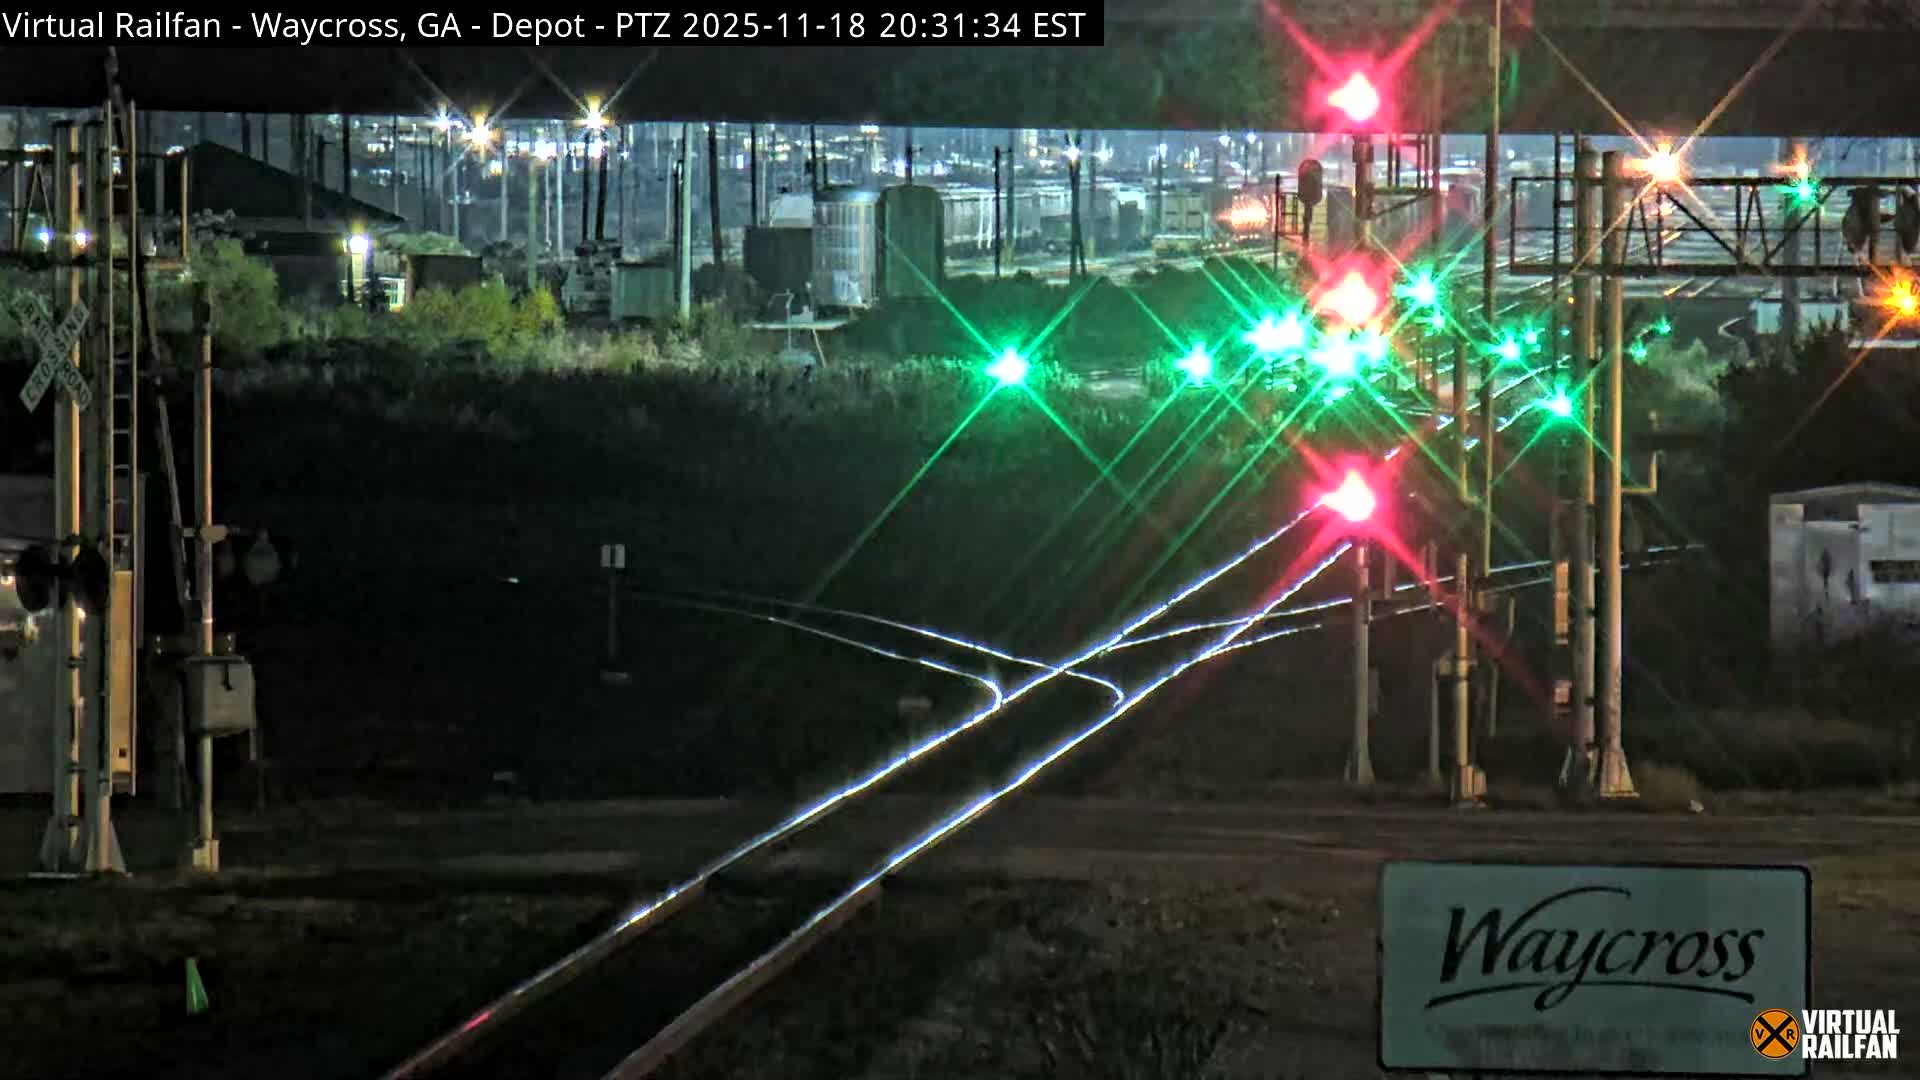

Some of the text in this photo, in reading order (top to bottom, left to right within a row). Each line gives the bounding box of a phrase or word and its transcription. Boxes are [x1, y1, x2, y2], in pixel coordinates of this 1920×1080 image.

[25, 304, 85, 403] CROSSING
[62, 360, 89, 405] ROAD
[1440, 886, 1765, 1011] Waycross
